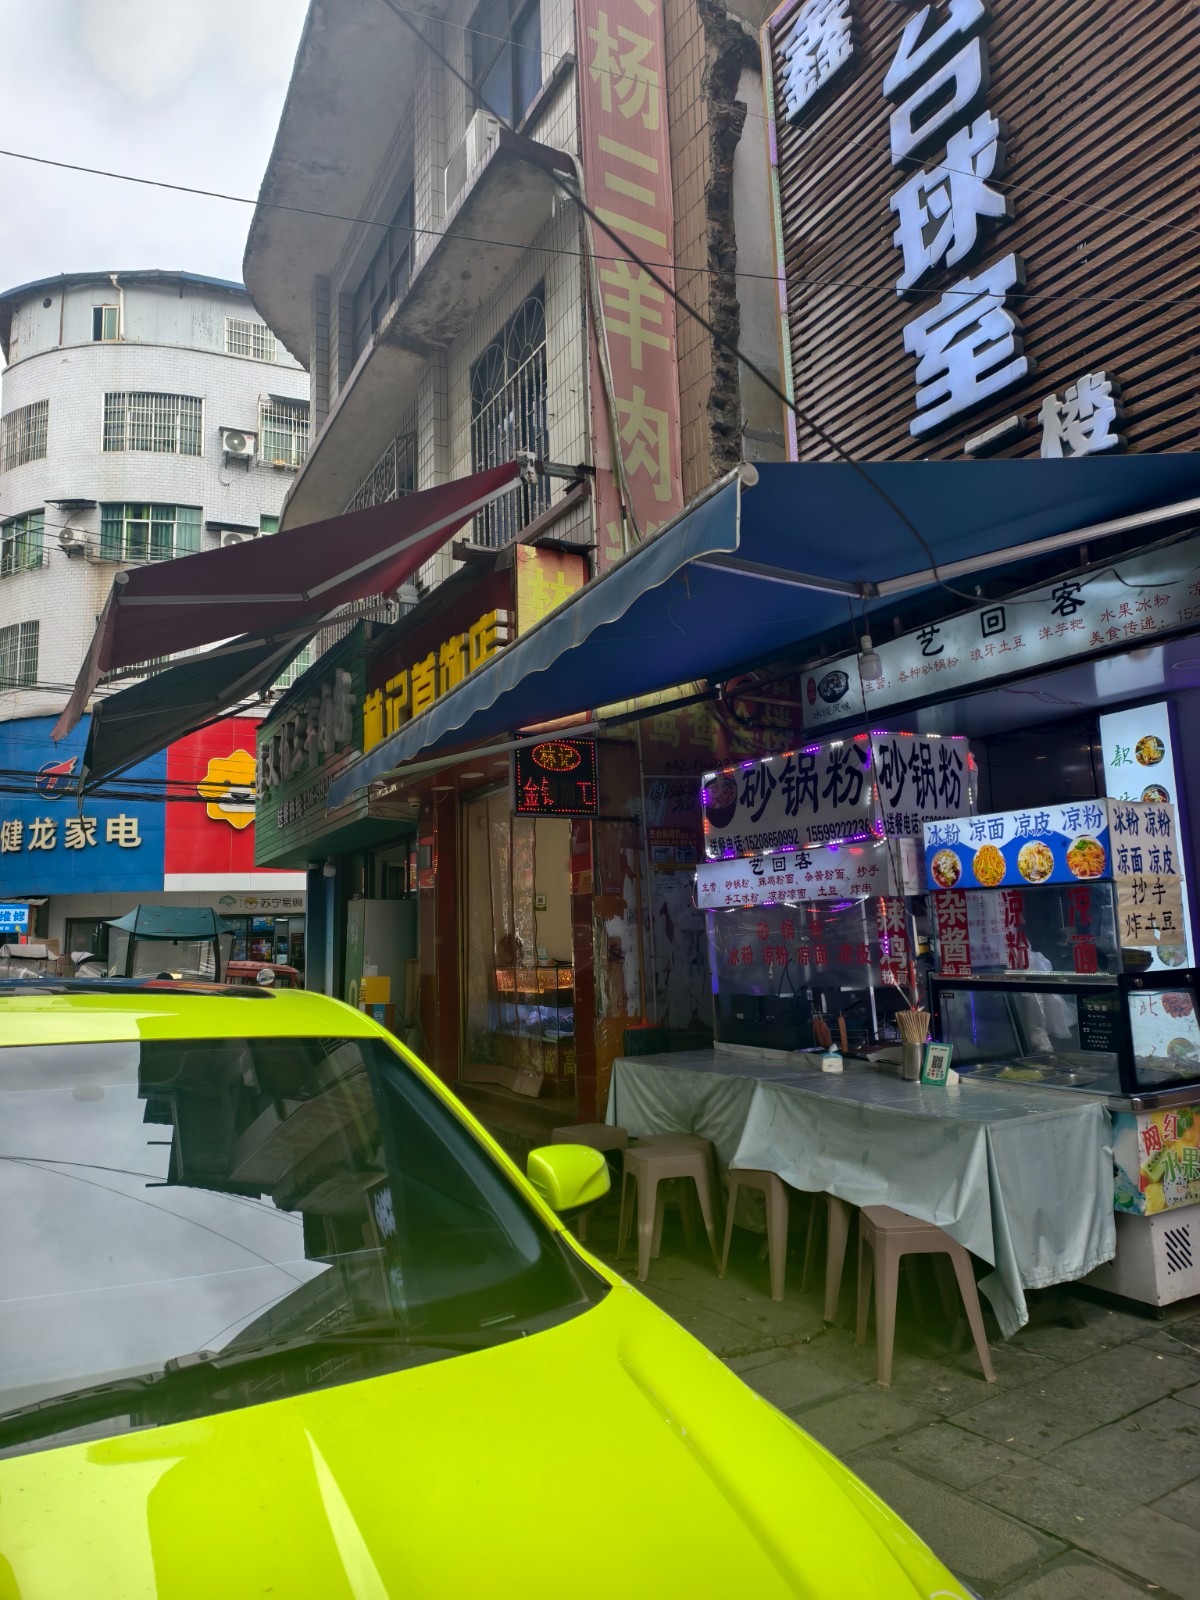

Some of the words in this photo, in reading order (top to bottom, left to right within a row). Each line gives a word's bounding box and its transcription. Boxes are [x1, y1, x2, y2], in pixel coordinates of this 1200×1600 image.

[883, 0, 1036, 440] 台球室
[586, 0, 673, 568] 杨三羊肉
[963, 369, 1124, 459] 一楼
[916, 581, 1086, 658] 艺回客
[1100, 593, 1171, 623] 水果冰粉
[897, 656, 959, 684] 各种砂锅粉
[1037, 617, 1086, 642] 洋芋粑
[739, 743, 867, 823] 砂锅粉
[878, 738, 964, 811] 砂锅粉
[0, 813, 143, 852] 健龙家电
[927, 822, 961, 847] 冰粉
[968, 816, 1004, 843] 凉面
[1013, 811, 1053, 837] 凉皮
[1061, 804, 1104, 832] 凉粉
[1113, 806, 1140, 836] 冰粉
[1144, 807, 1172, 838] 凉粉
[748, 851, 813, 876] 艺回客
[1116, 846, 1144, 875] 凉面
[1148, 847, 1177, 876] 凉皮
[260, 897, 303, 909] 苏宁易购
[1131, 876, 1167, 906] 抄手
[938, 889, 970, 965] 杂酱
[1002, 889, 1030, 971] 凉粉
[1066, 885, 1098, 974] 凉面
[1125, 910, 1177, 940] 炸土豆
[727, 944, 754, 966] 冰粉
[1141, 1113, 1181, 1157] 网红
[1161, 1146, 1200, 1183] 水果
